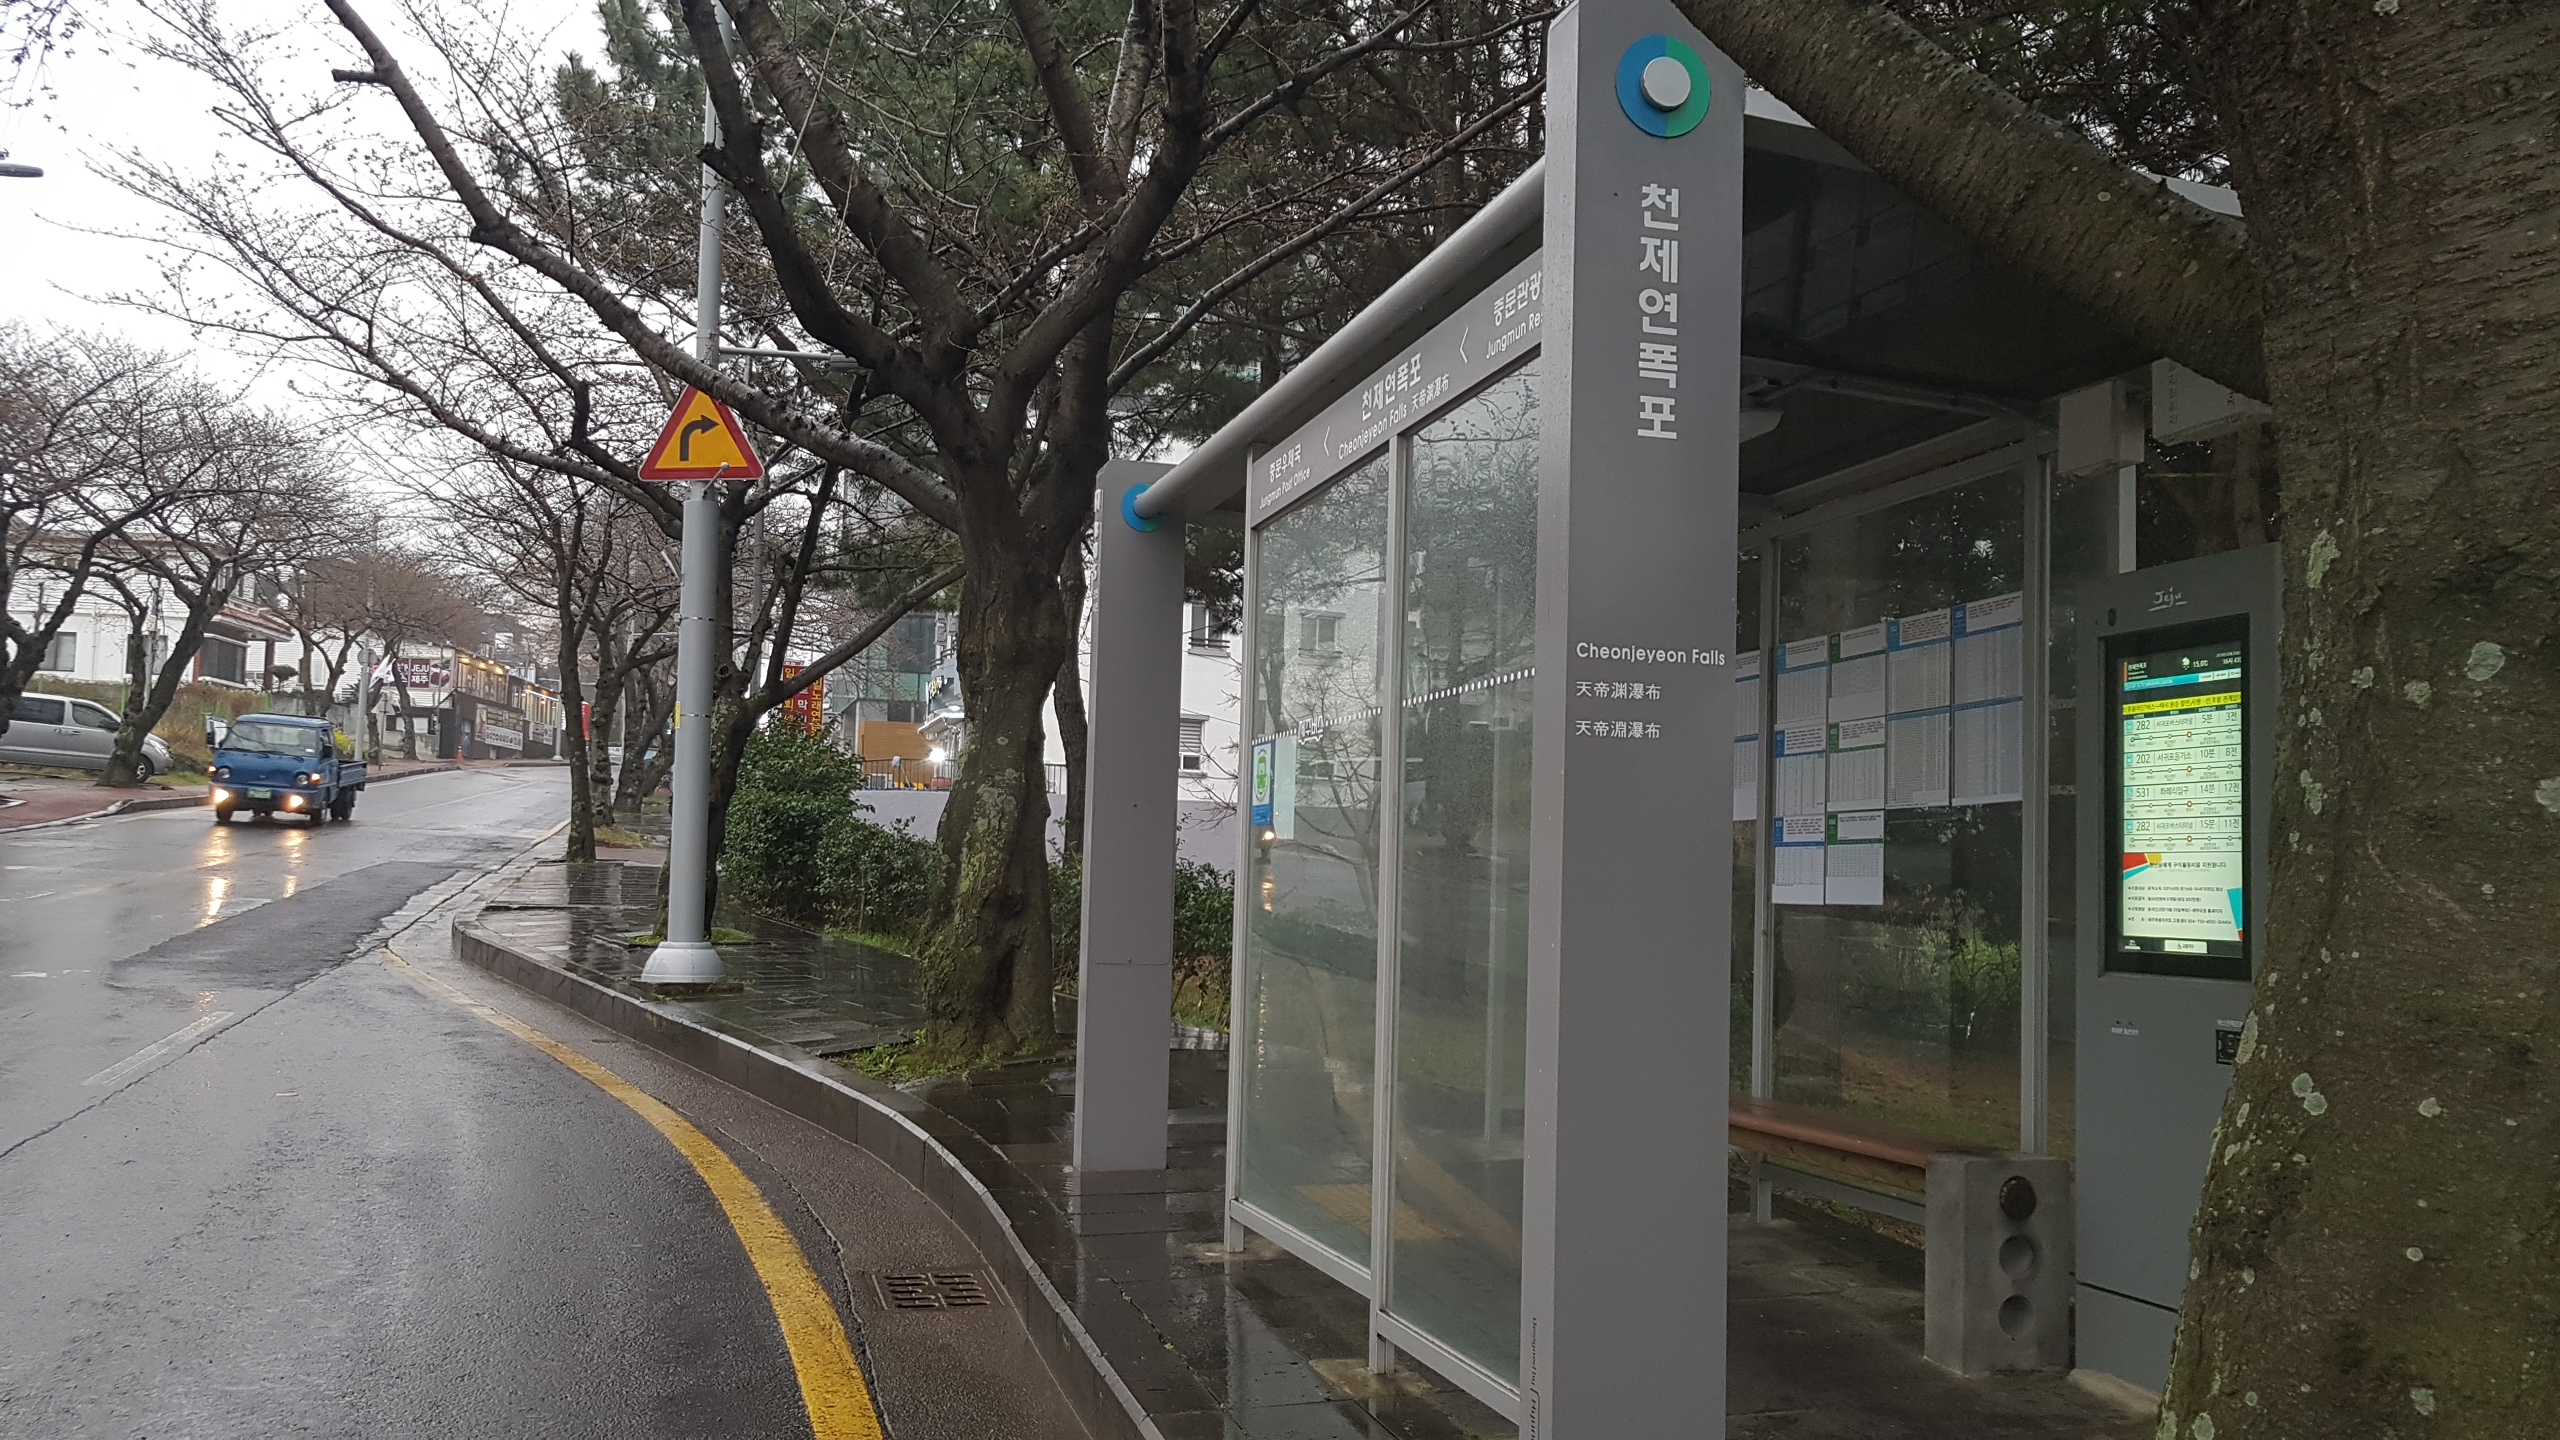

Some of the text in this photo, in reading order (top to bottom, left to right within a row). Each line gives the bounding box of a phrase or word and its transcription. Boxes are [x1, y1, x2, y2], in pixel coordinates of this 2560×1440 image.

[1637, 183, 1679, 440] 천제연폭포
[1486, 320, 1527, 360] Jungmun
[1361, 352, 1421, 421] 천제연폭포
[1338, 418, 1388, 460] Cheonjeyeon
[1389, 403, 1408, 428] Falls
[1269, 443, 1301, 484] 중문우체국
[1259, 466, 1311, 510] Jungmun Post Office
[2152, 586, 2183, 609] Jeju
[1576, 642, 1687, 664] Cheonjeyeon
[1692, 648, 1726, 666] Falls
[411, 664, 430, 672] JEJU
[411, 675, 429, 684] 제주
[1575, 681, 1662, 701] 天帝渊瀑布
[1575, 720, 1662, 739] 天帝淵瀑布
[2136, 720, 2151, 731] 282
[2201, 714, 2213, 724] 5분
[2136, 754, 2151, 764] 202
[2200, 748, 2215, 759] 10분
[2136, 787, 2150, 797] 531
[2200, 783, 2215, 794] 14분
[2136, 821, 2151, 831] 282
[2200, 819, 2215, 829] 15분
